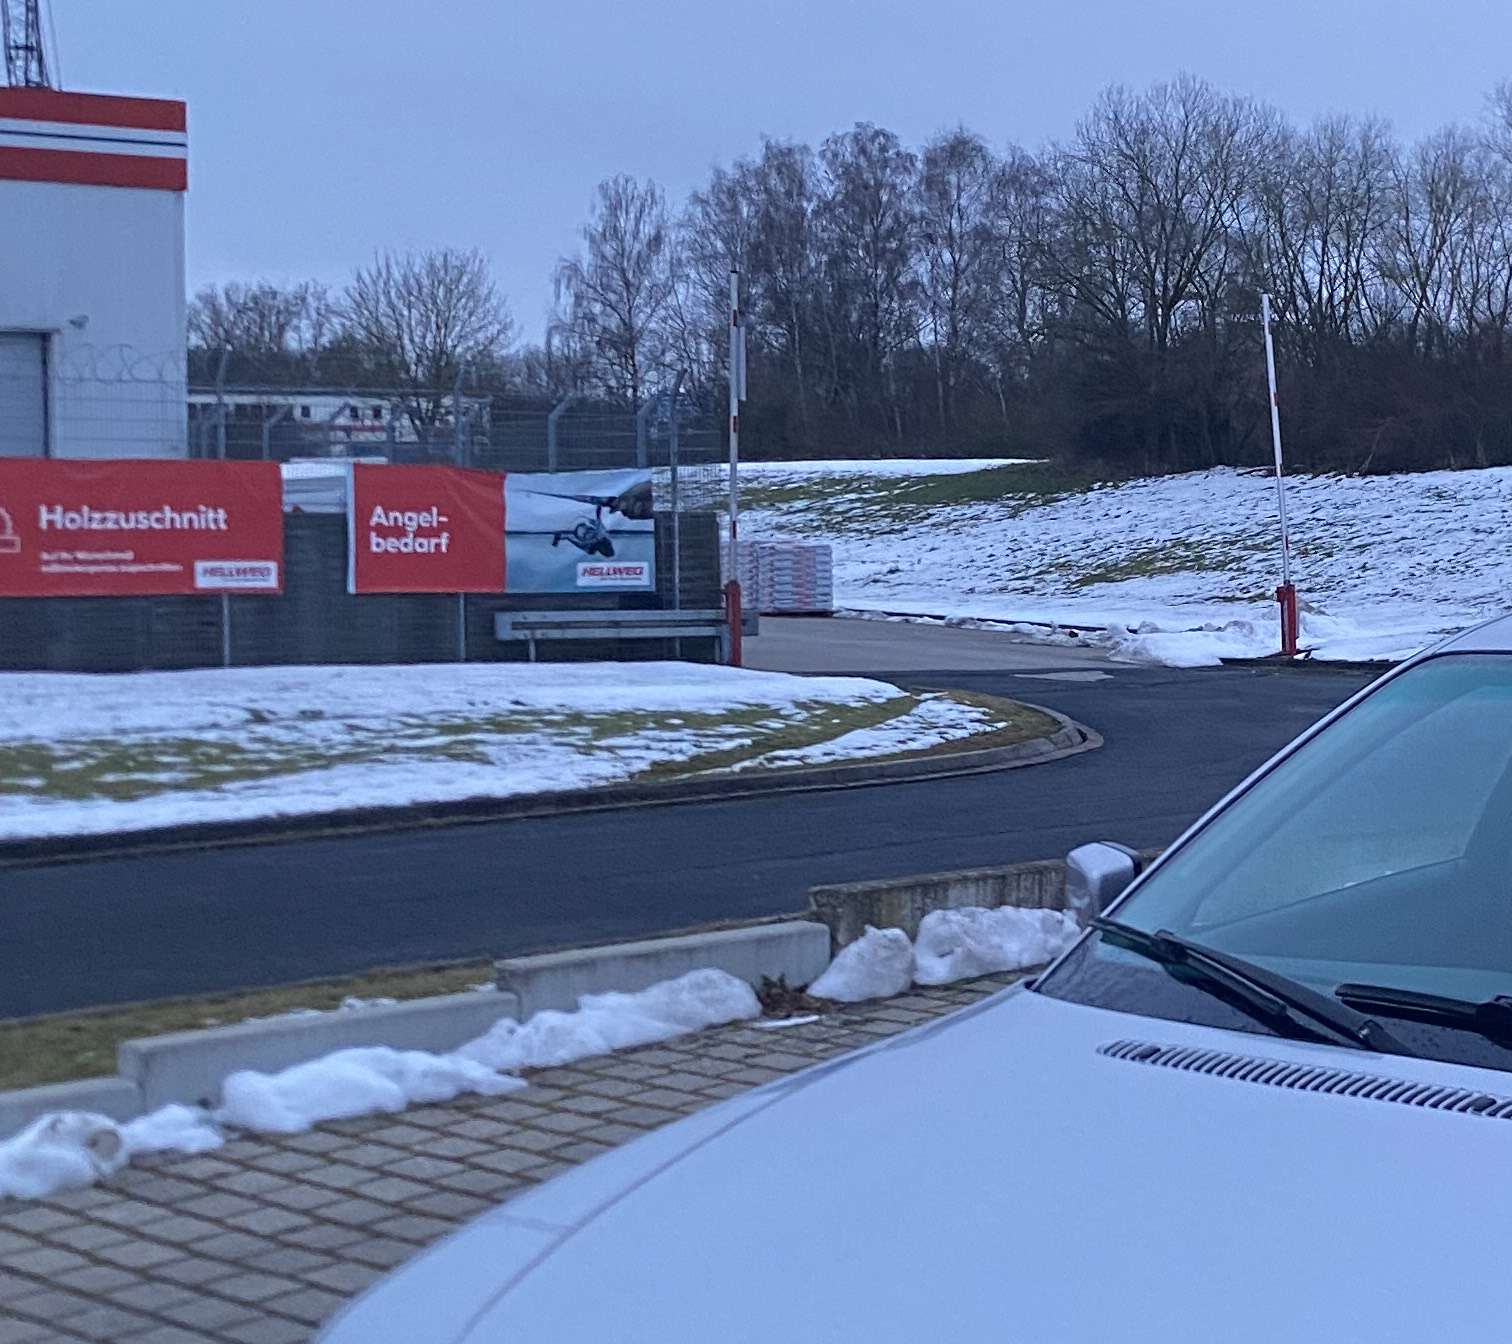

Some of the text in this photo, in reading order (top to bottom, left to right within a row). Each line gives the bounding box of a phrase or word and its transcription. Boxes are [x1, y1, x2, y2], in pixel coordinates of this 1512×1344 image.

[38, 504, 228, 530] Holzzuschnitt
[369, 505, 448, 531] Angel-
[370, 532, 449, 553] bedarf
